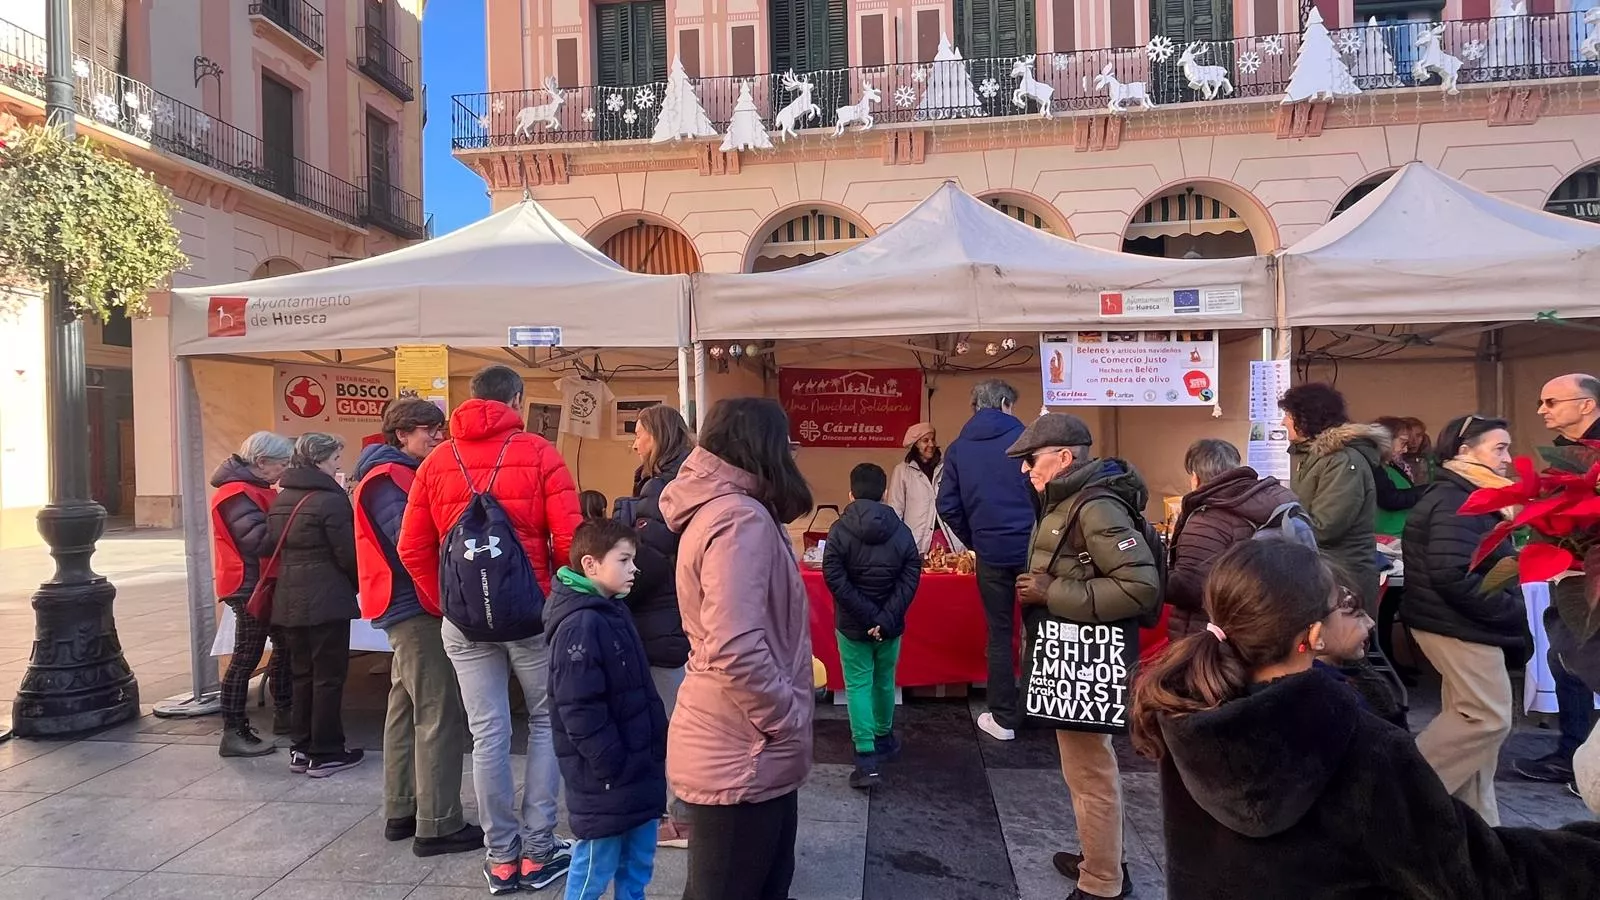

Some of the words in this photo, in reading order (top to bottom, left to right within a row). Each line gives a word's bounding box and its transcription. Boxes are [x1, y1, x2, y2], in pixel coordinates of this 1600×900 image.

[251, 295, 351, 312] Ayuntamiento
[250, 313, 268, 327] de
[272, 312, 327, 326] Huesca
[1076, 346, 1110, 354] Belenes
[1148, 346, 1182, 354] navideños
[1100, 356, 1142, 364] Comercio
[1144, 356, 1168, 364] Justo
[336, 383, 389, 398] BOSCO
[810, 398, 857, 414] Navidad
[859, 398, 912, 414] Solidaria
[822, 421, 884, 433] Cáritas
[480, 568, 489, 597] UNDER
[484, 597, 494, 630] ARMOUR
[1029, 675, 1056, 688] kata
[1027, 684, 1056, 697] krak
